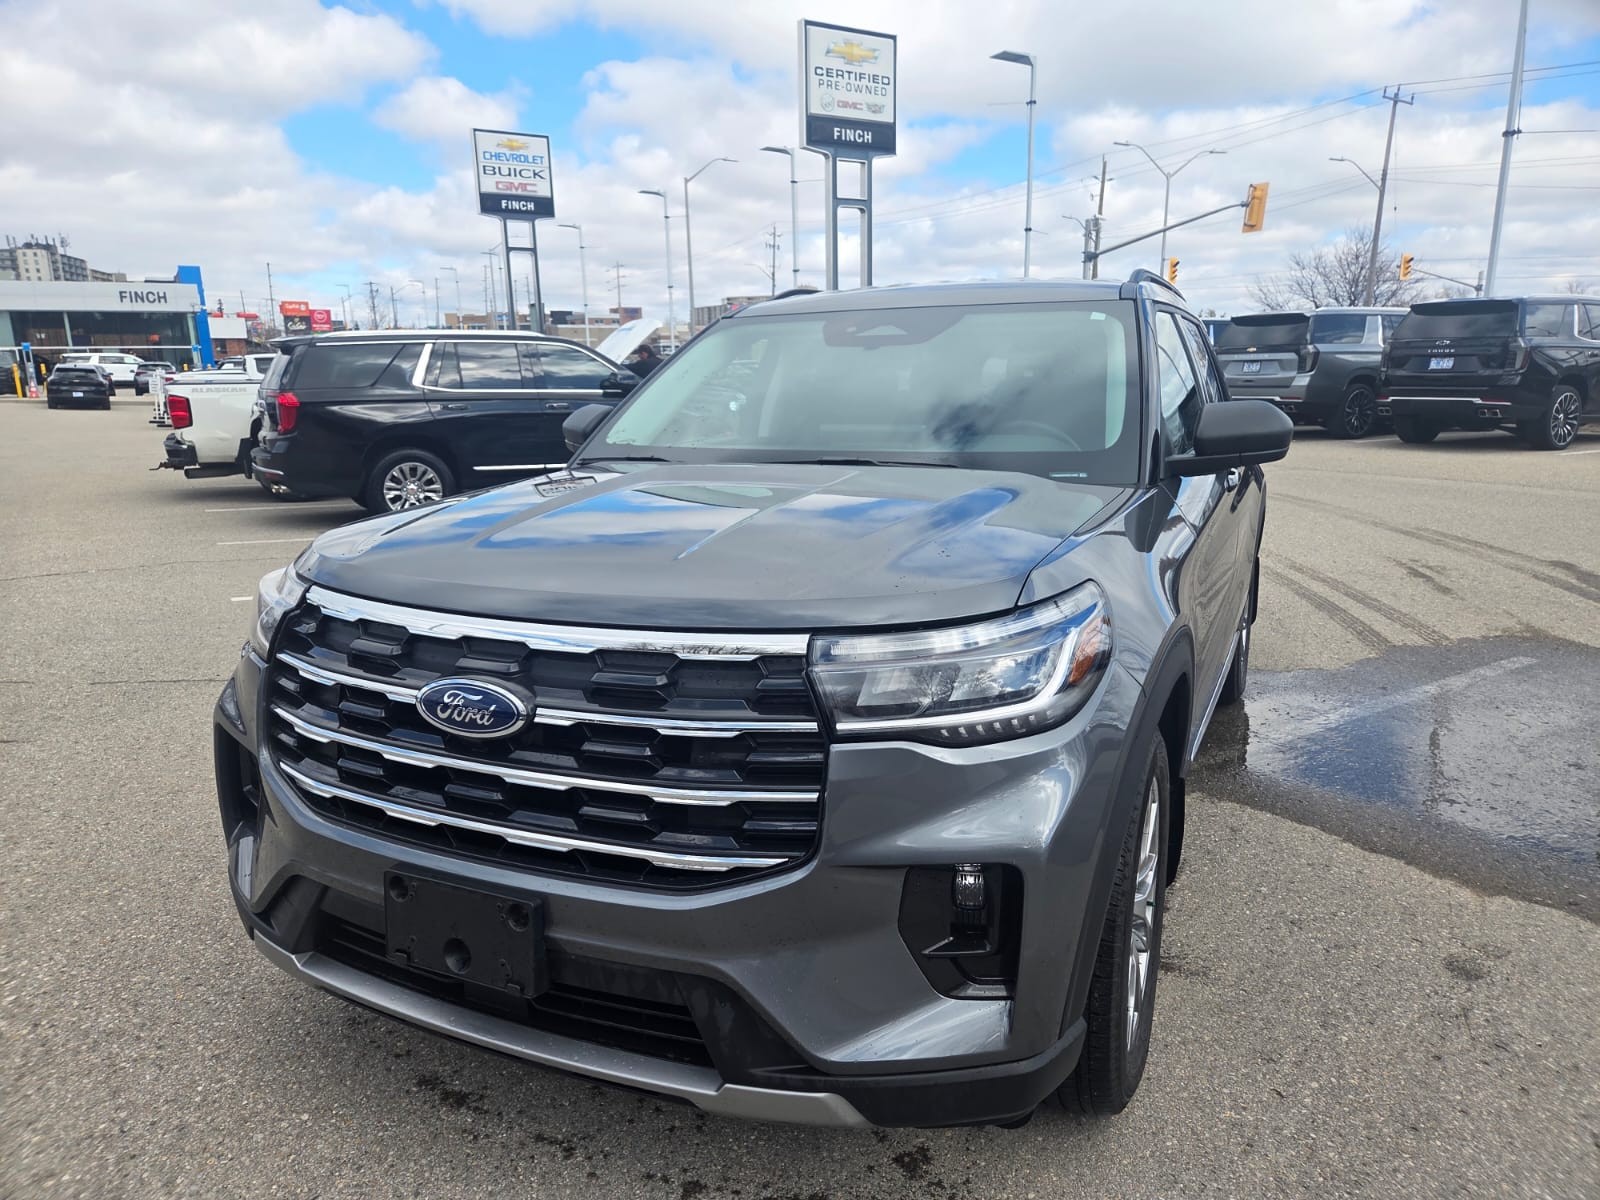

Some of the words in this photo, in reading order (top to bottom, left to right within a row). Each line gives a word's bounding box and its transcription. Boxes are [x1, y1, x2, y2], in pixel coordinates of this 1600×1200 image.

[814, 66, 891, 86] CERTIFIED
[818, 78, 887, 97] PRE-OWNED
[836, 99, 864, 111] GMC
[833, 127, 872, 143] FINCH
[482, 150, 544, 165] CHEVROLET
[482, 165, 547, 180] BUICK
[495, 180, 538, 193] GMC
[501, 199, 535, 211] FINCH
[118, 290, 168, 304] FINCH
[436, 689, 497, 726] Ford
